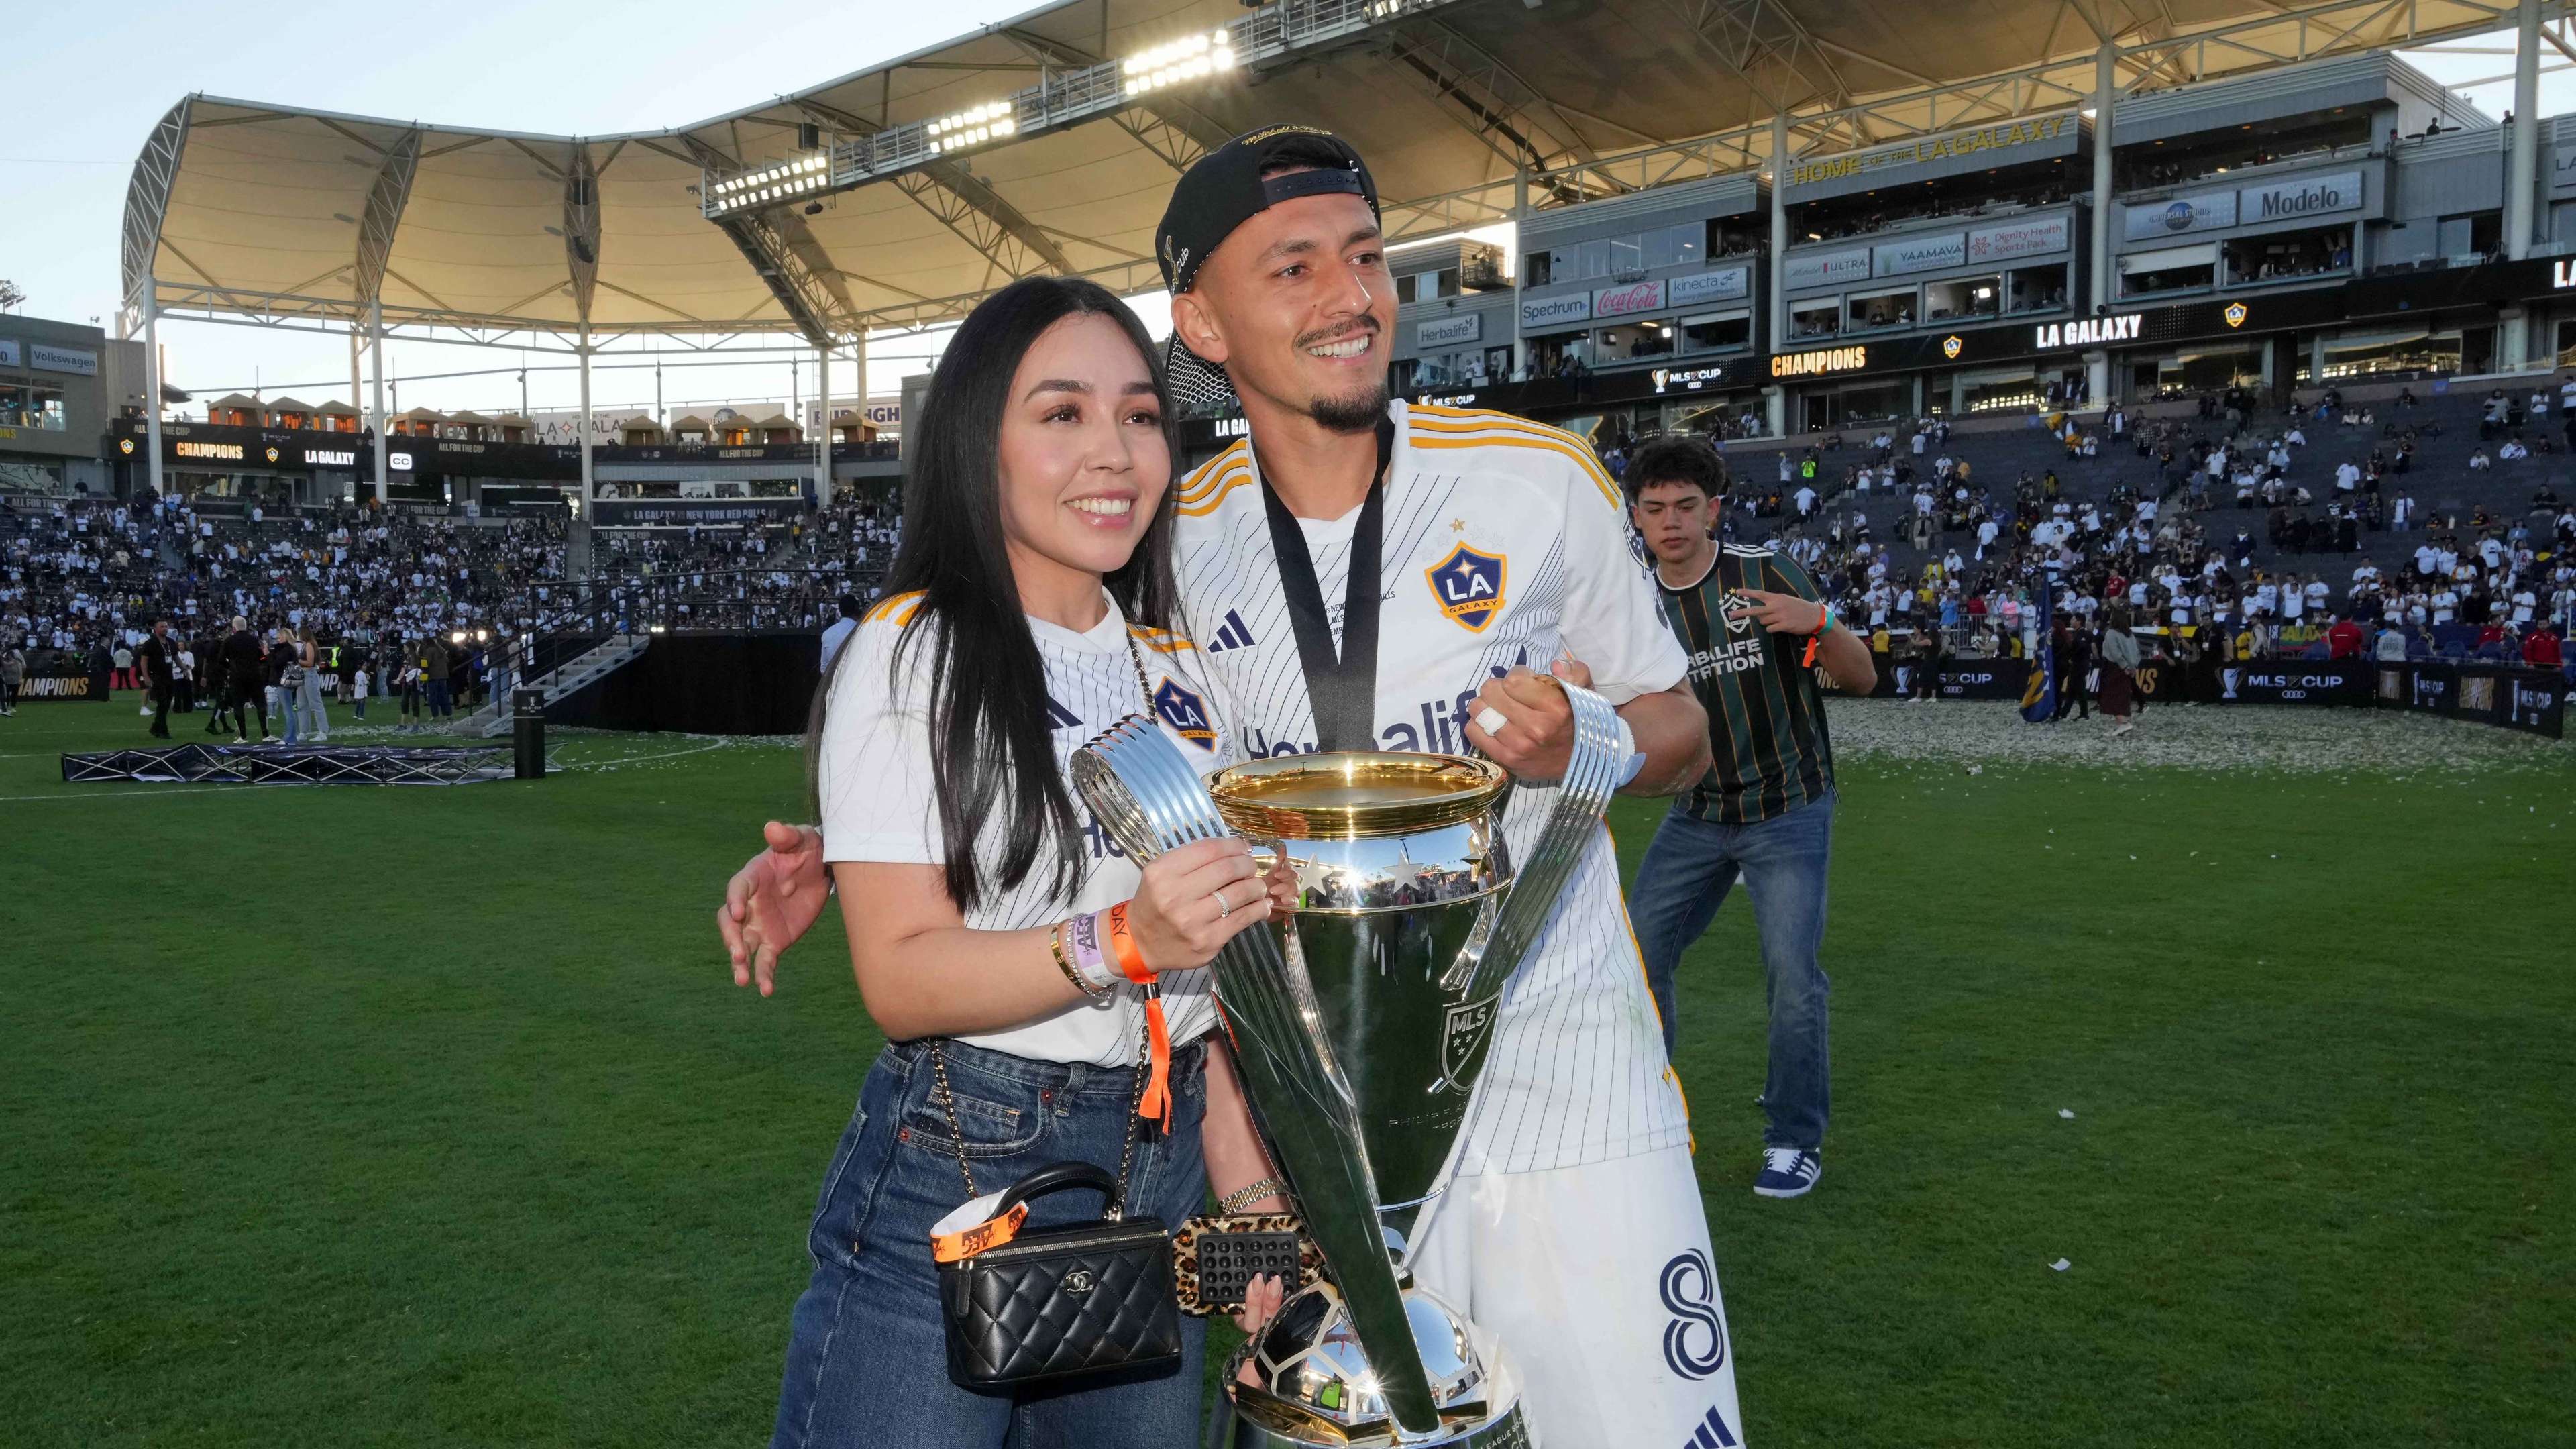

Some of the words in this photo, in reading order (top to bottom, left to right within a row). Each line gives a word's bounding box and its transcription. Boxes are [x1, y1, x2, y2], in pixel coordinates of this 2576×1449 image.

[1794, 154, 1862, 184] HOME
[1868, 156, 1884, 166] OF
[1889, 151, 1911, 160] THE
[1915, 139, 1949, 162] LA
[1951, 113, 2067, 156] GALAXY
[2262, 184, 2339, 217] Modelo
[1995, 231, 2029, 244] Dignity
[2030, 225, 2062, 237] Health
[1995, 243, 2025, 254] Sports
[2027, 239, 2046, 249] Park
[1176, 248, 1189, 274] CUP
[1830, 258, 1866, 272] ULTRA
[2554, 259, 2576, 288] LA
[1674, 276, 1718, 292] kinecta
[1597, 282, 1660, 315] Coca-Cola
[1523, 301, 1582, 321] Spectrum
[1421, 324, 1469, 342] Herbalife
[2036, 325, 2058, 348] LA
[2064, 314, 2143, 345] GALAXY
[34, 350, 96, 368] Volkswagen
[1771, 345, 1866, 377] CHAMPIONS
[1670, 371, 1691, 382] MLS
[1699, 368, 1721, 380] CUP
[1433, 397, 1451, 408] MLS
[1456, 394, 1475, 405] CUP
[134, 424, 148, 434] ALL
[162, 425, 175, 435] THE
[176, 427, 191, 437] CUP
[536, 421, 558, 436] LA
[1215, 420, 1229, 437] LA
[176, 442, 243, 460] CHAMPIONS
[439, 442, 449, 451] ALL
[449, 443, 461, 452] FOR
[461, 444, 473, 453] THE
[473, 445, 485, 453] CUP
[718, 449, 730, 458] ALL
[741, 449, 752, 458] THE
[305, 450, 318, 464] LA
[318, 451, 355, 465] GALAXY
[392, 458, 410, 466] CC
[11, 497, 26, 508] ALL
[27, 498, 42, 508] FOR
[423, 506, 437, 515] THE
[633, 510, 644, 520] LA
[686, 509, 704, 519] NEW
[704, 509, 726, 519] YORK
[726, 509, 741, 519] RED
[1446, 573, 1494, 601] LA
[1330, 602, 1345, 612] NEW
[1449, 600, 1497, 614] GALAXY
[1331, 614, 1344, 623] MLS
[1960, 673, 1993, 684] CUP
[2248, 675, 2287, 687] MLS
[2302, 675, 2343, 688] CUP
[2419, 679, 2431, 693] MLS
[2432, 681, 2445, 694] CUP
[2520, 689, 2533, 707] MLS
[2537, 691, 2552, 710] CUP
[1164, 704, 1206, 727] LA
[1111, 903, 1128, 936] DAY
[1450, 1006, 1487, 1035] MLS
[1659, 1248, 1725, 1381] 8
